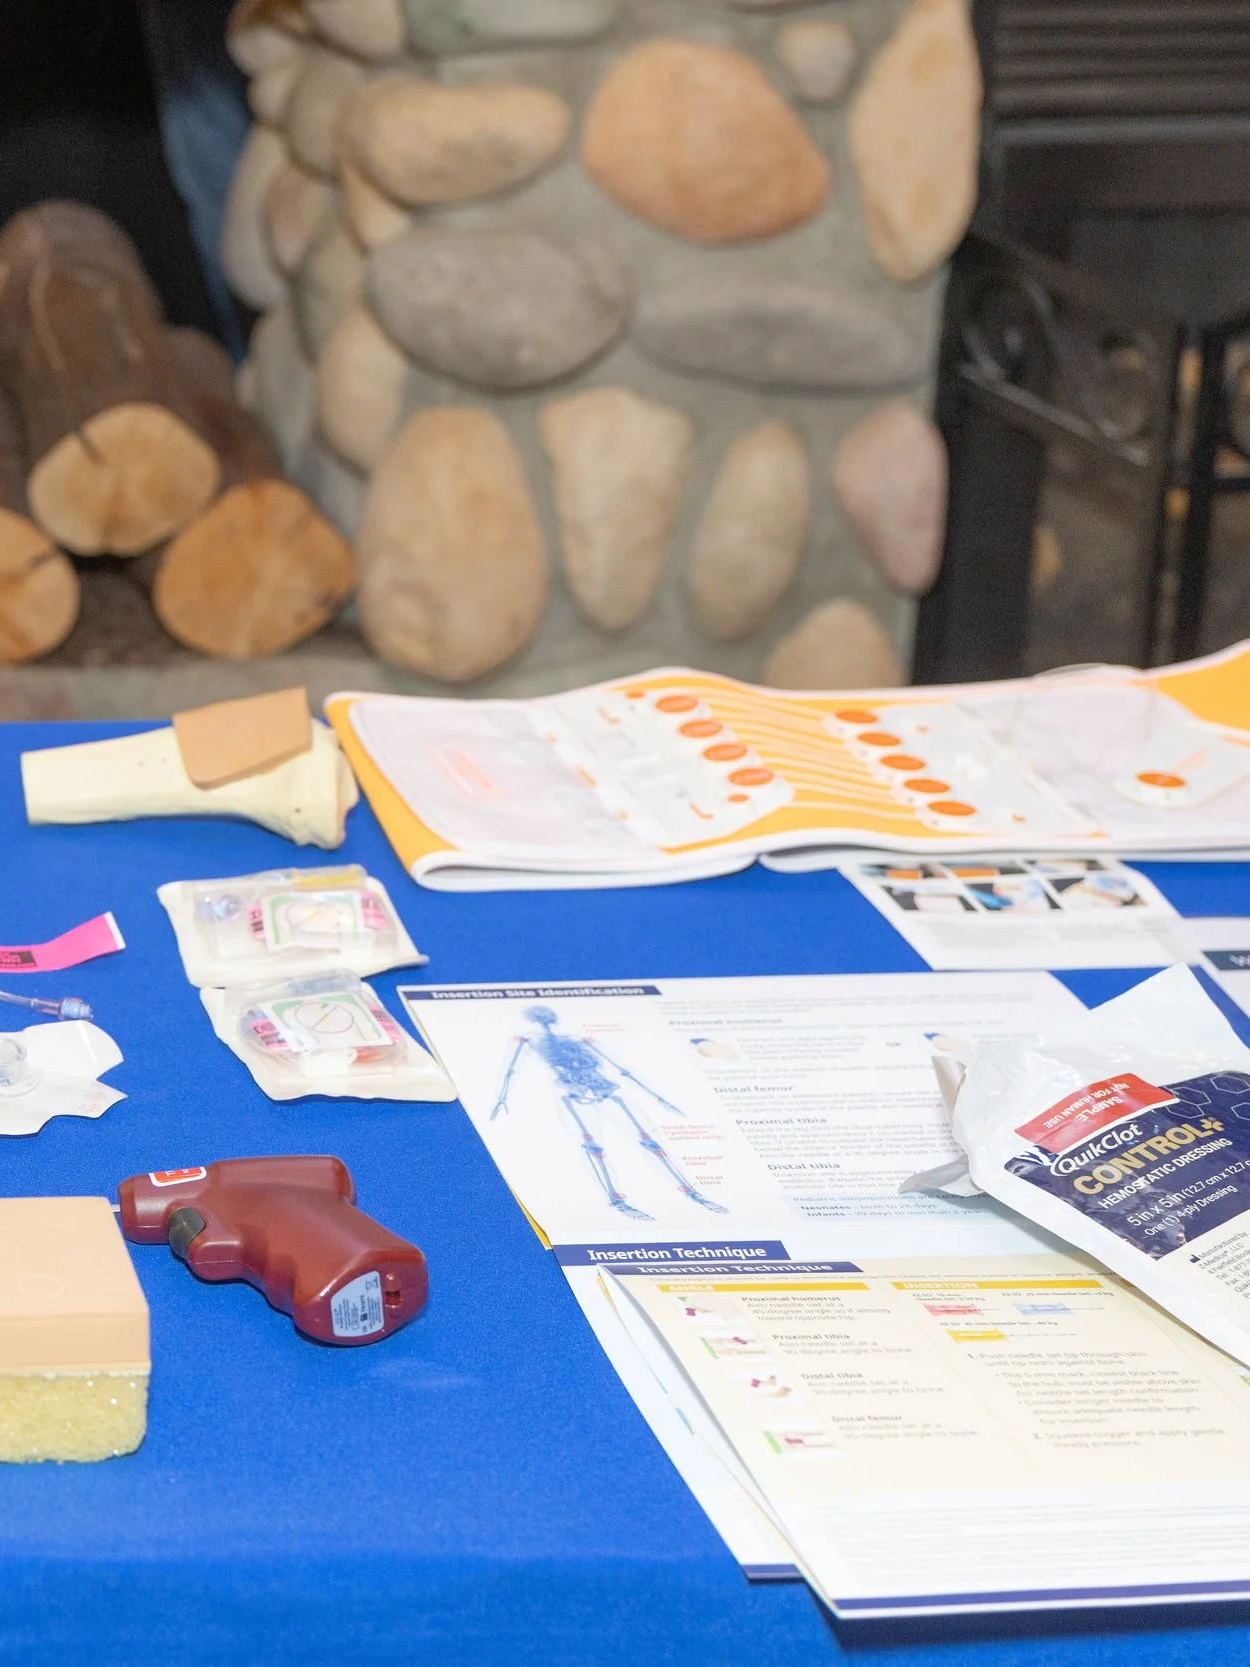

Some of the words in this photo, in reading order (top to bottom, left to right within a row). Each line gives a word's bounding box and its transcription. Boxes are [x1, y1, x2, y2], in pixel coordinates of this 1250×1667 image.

[431, 990, 503, 999] Insertion
[505, 989, 536, 997] Site
[538, 986, 646, 997] Identification
[1111, 1082, 1130, 1093] NOT
[1093, 1088, 1112, 1099] FOR
[1061, 1094, 1093, 1116] HUMAN
[1075, 1096, 1124, 1122] SAMPLE
[735, 1118, 794, 1127] Proximal
[797, 1117, 827, 1125] tibia
[1042, 1113, 1062, 1128] USE
[1058, 1123, 1143, 1174] QuikClot
[767, 1163, 806, 1171] Distal
[1098, 1163, 1176, 1209] HEMOSTATIC
[1173, 1137, 1233, 1168] DRESSING
[1126, 1215, 1141, 1227] 5
[1138, 1210, 1155, 1222] in
[1152, 1205, 1165, 1215] x
[1160, 1197, 1174, 1208] 5
[1170, 1190, 1185, 1204] in
[1182, 1180, 1207, 1198] (12.7
[1206, 1173, 1223, 1186] cm
[1221, 1171, 1229, 1179] x
[1225, 1160, 1246, 1175] 12.7
[1144, 1223, 1167, 1236] One
[1164, 1214, 1180, 1227] (1)
[1176, 1204, 1201, 1221] 4-ply
[1195, 1184, 1238, 1208] Dressing
[587, 1248, 672, 1261] Insertion
[676, 1247, 767, 1260] Technique
[730, 1264, 833, 1273] Technique
[902, 1282, 979, 1290] INSERTION
[1079, 1351, 1124, 1359] through
[1057, 1359, 1095, 1367] against
[1067, 1379, 1094, 1387] must
[1036, 1388, 1072, 1396] needle
[1092, 1388, 1128, 1396] length
[1073, 1398, 1110, 1406] longer
[1073, 1407, 1124, 1416] adequate
[1163, 1405, 1202, 1414] length
[1044, 1432, 1091, 1440] Squeeze
[1092, 1431, 1130, 1440] trigger
[1158, 1429, 1188, 1438] apply
[1053, 1441, 1090, 1449] steady
